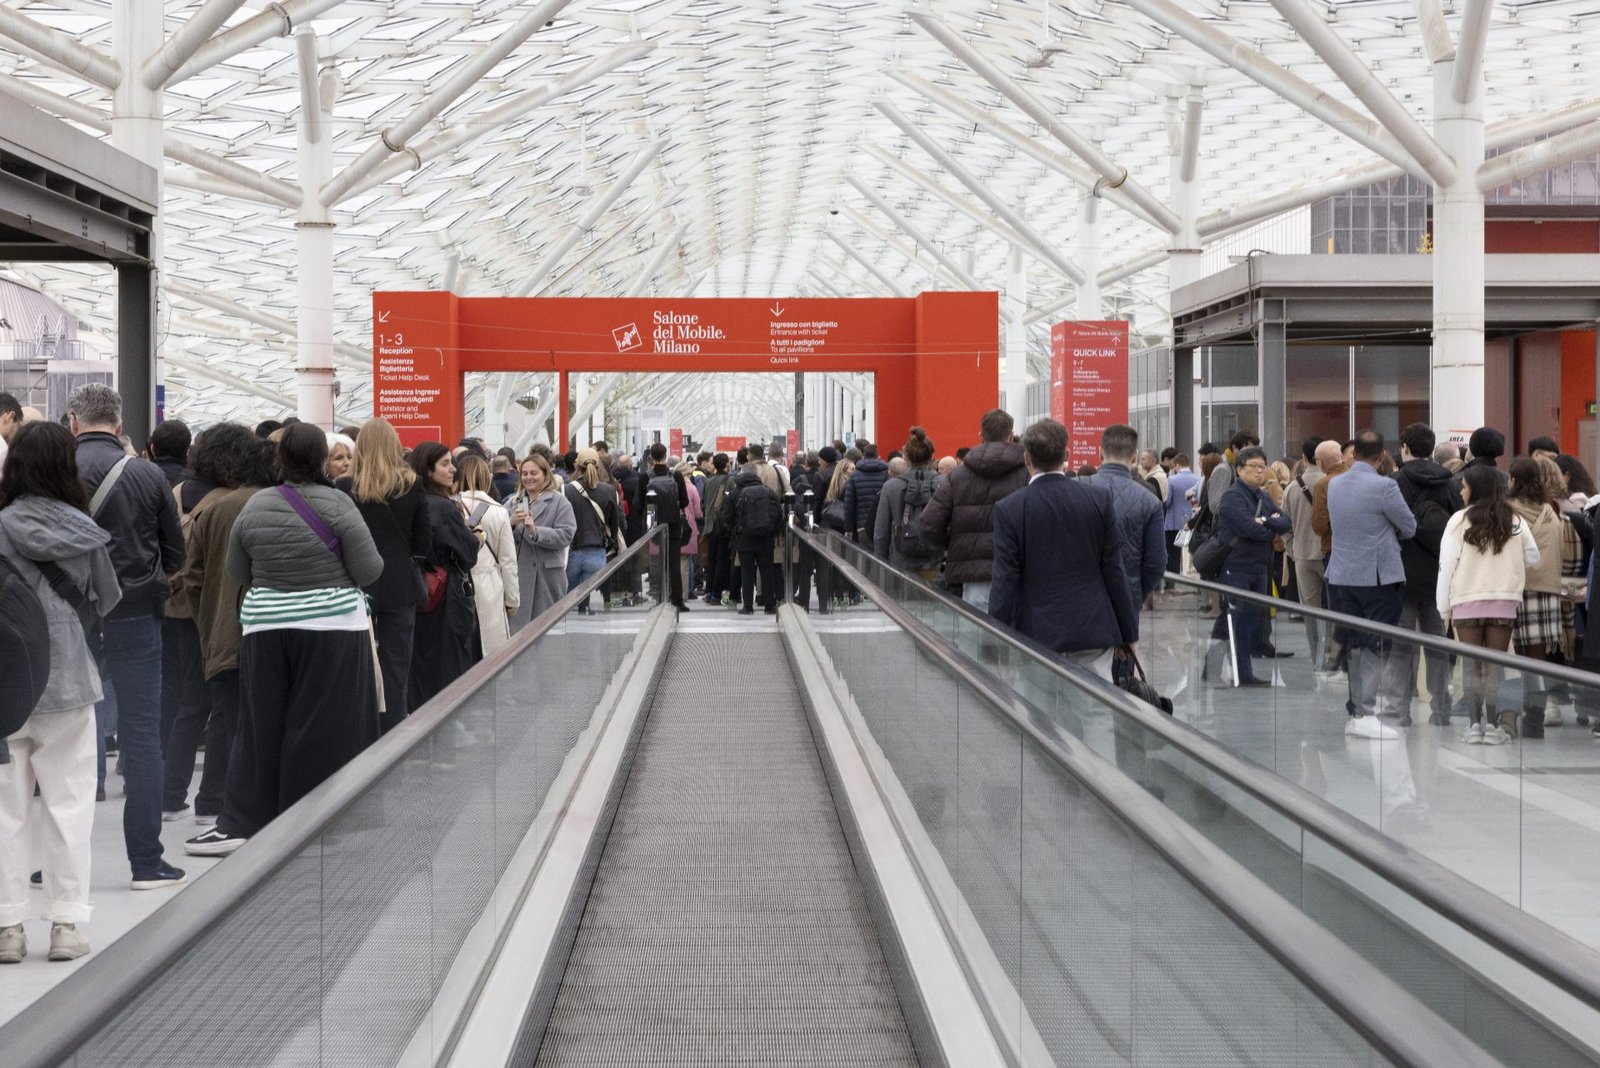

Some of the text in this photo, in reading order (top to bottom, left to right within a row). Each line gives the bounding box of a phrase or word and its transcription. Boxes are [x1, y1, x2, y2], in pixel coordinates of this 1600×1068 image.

[653, 310, 699, 325] Salone
[770, 321, 798, 329] Ingresso
[811, 321, 838, 329] biglietto
[653, 325, 674, 339] del
[677, 325, 726, 339] Mobile.
[653, 339, 700, 354] Milano
[794, 339, 825, 347] padiglioni
[379, 347, 414, 355] Reception
[1073, 349, 1116, 357] QUICK LINK
[379, 366, 414, 374] Biglietteria
[398, 374, 414, 382] Help
[379, 388, 440, 396] Assistenza Ingressi
[380, 412, 398, 420] Agent
[399, 412, 414, 420] Help
